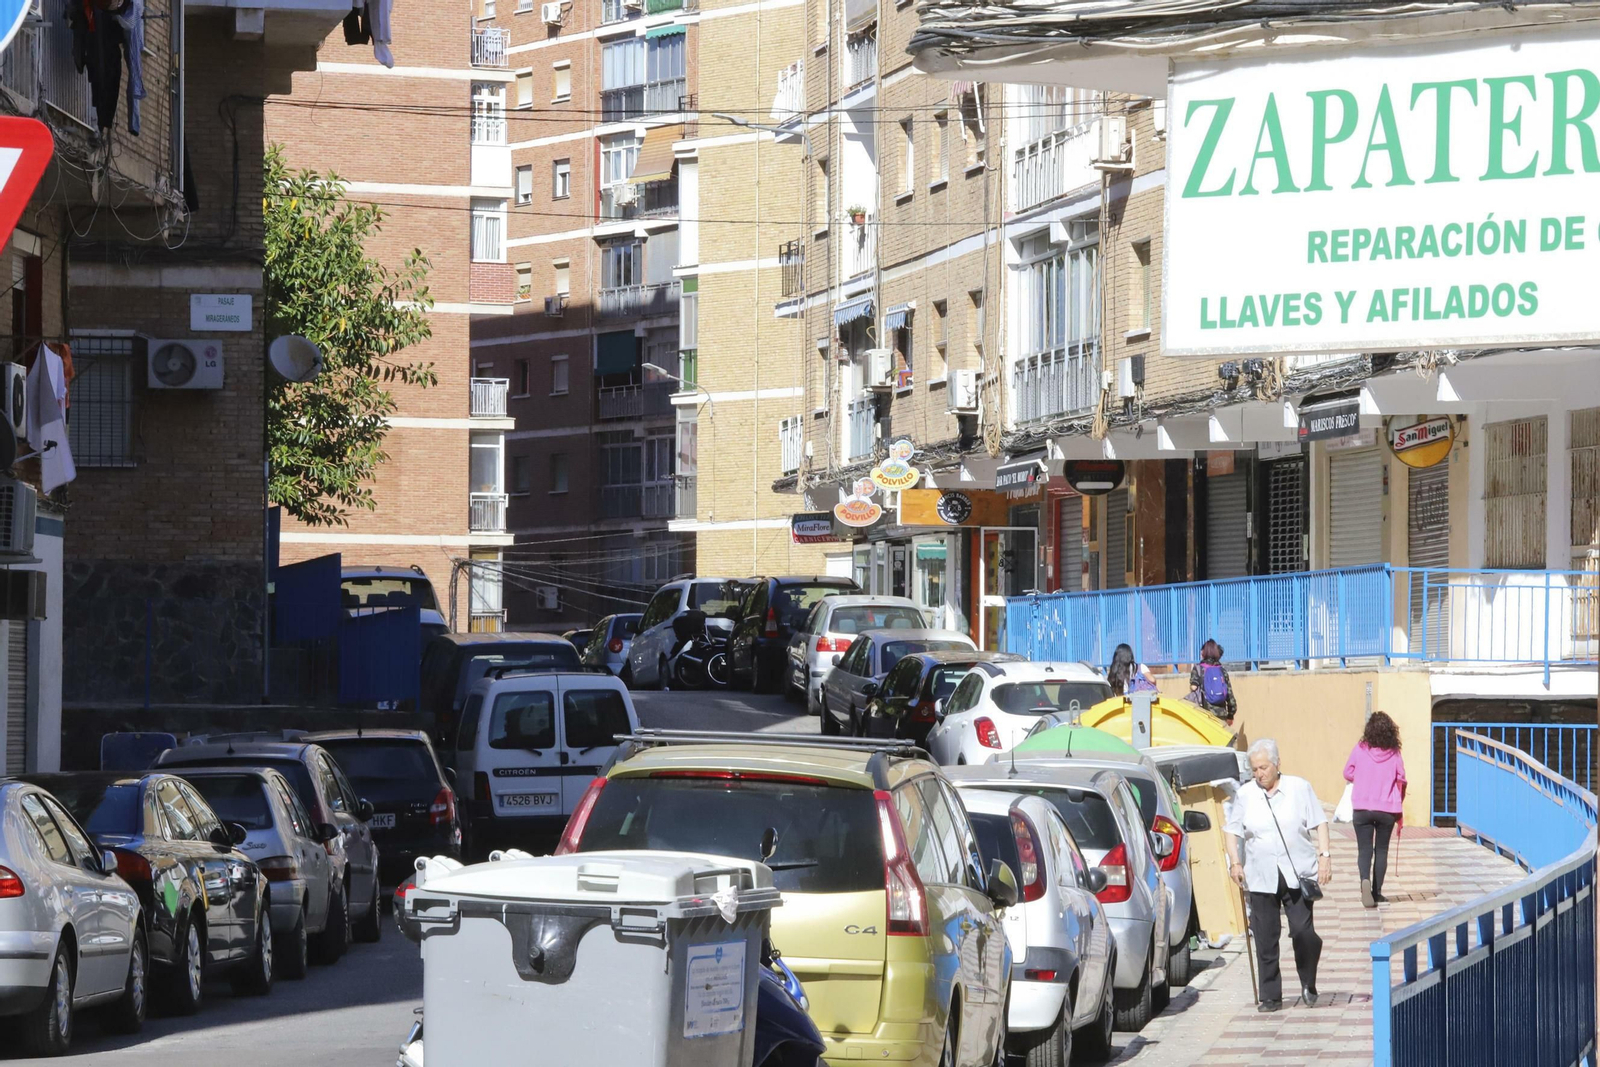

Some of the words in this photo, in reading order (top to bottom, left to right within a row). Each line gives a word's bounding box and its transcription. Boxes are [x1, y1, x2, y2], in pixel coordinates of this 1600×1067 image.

[1181, 68, 1600, 199] ZAPATER
[1307, 212, 1527, 264] REPARACIÓN
[1540, 216, 1586, 252] DE
[218, 297, 235, 306] PASAJE
[1200, 291, 1323, 330] LLAVES
[1335, 290, 1357, 324] Y
[1366, 281, 1539, 324] AFILADOS
[205, 360, 217, 368] LG
[1310, 416, 1335, 433] MARISCOS
[876, 472, 914, 486] POLVILLO
[840, 508, 876, 521] POLVILLO
[506, 795, 531, 806] 4526
[534, 794, 553, 805] BVJ
[372, 815, 395, 827] HKF
[844, 924, 878, 936] C4
